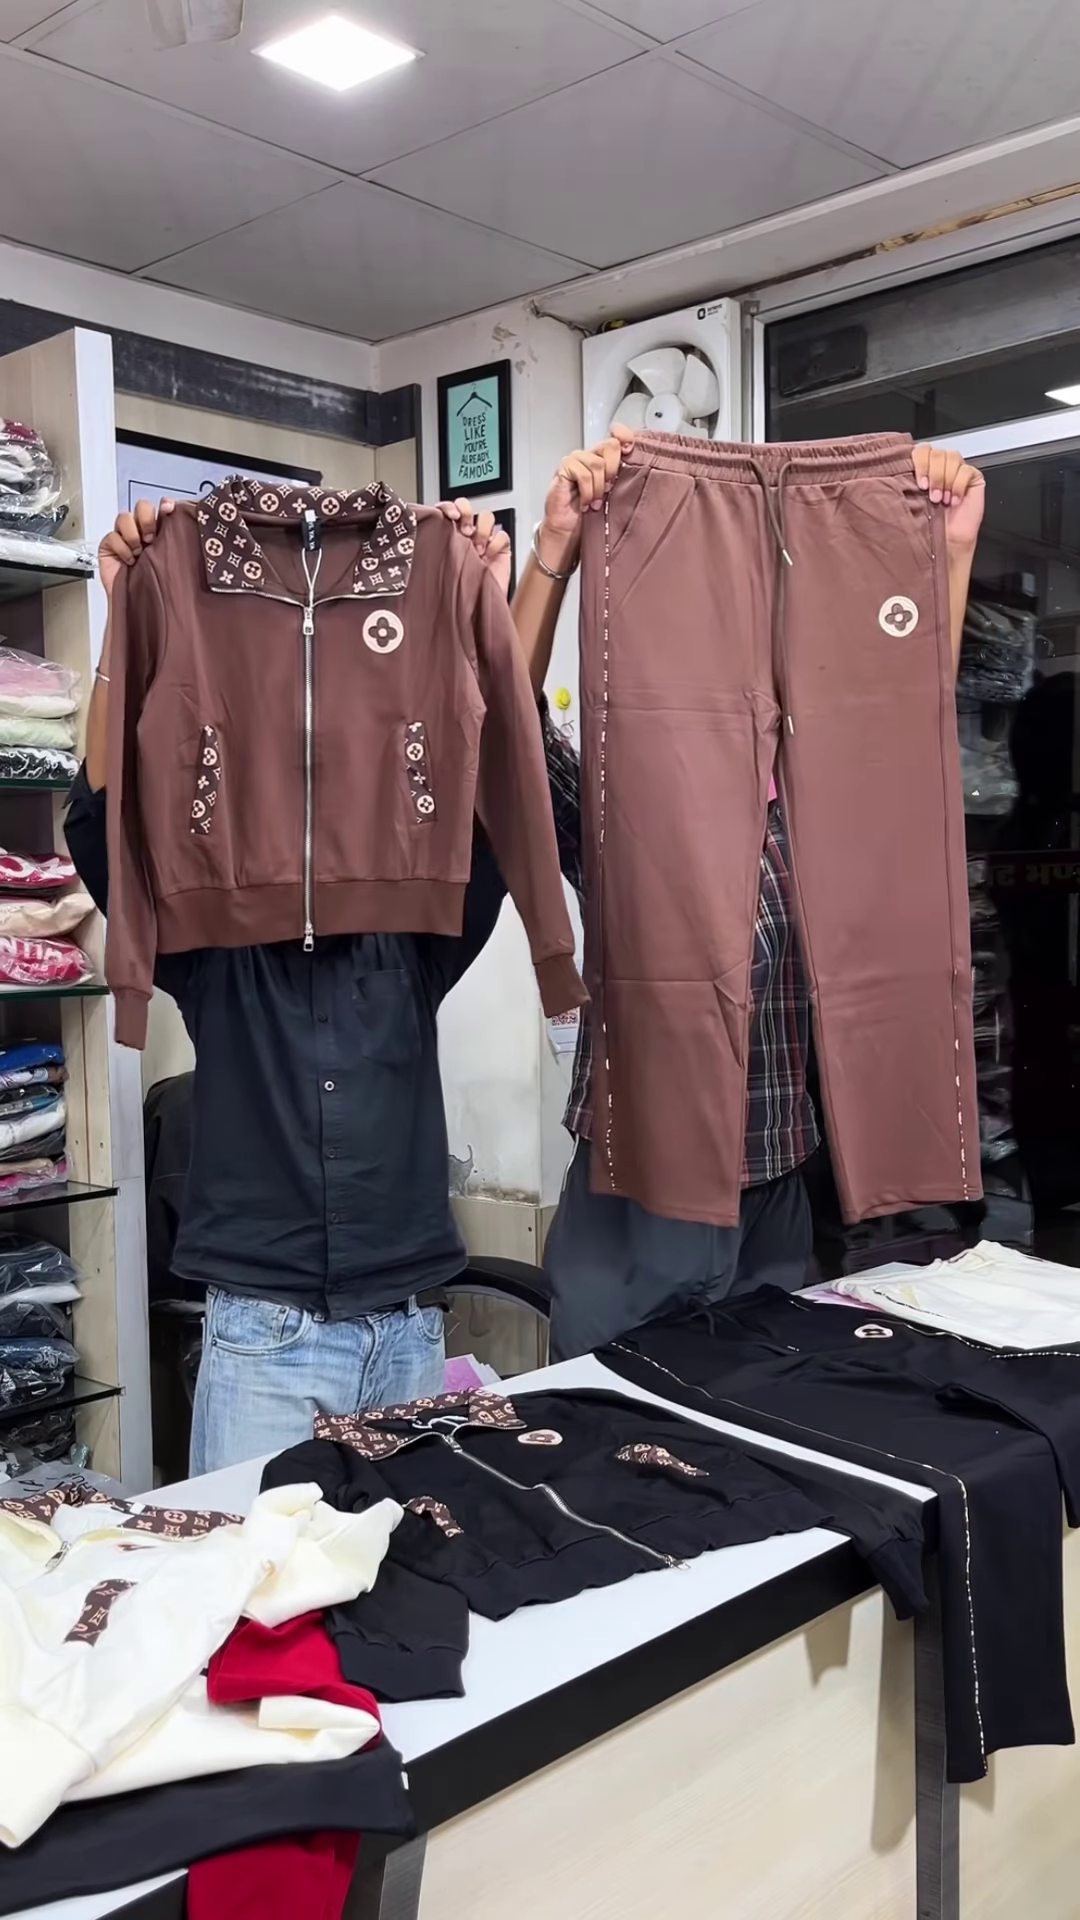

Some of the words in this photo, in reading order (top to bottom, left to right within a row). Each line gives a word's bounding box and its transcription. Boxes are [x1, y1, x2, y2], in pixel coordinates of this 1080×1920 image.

[462, 412, 487, 427] DRESS
[464, 424, 486, 441] LIKE
[464, 438, 488, 453] YOU'RE
[461, 450, 490, 464] ALREADY
[459, 460, 494, 479] FAMOUS
